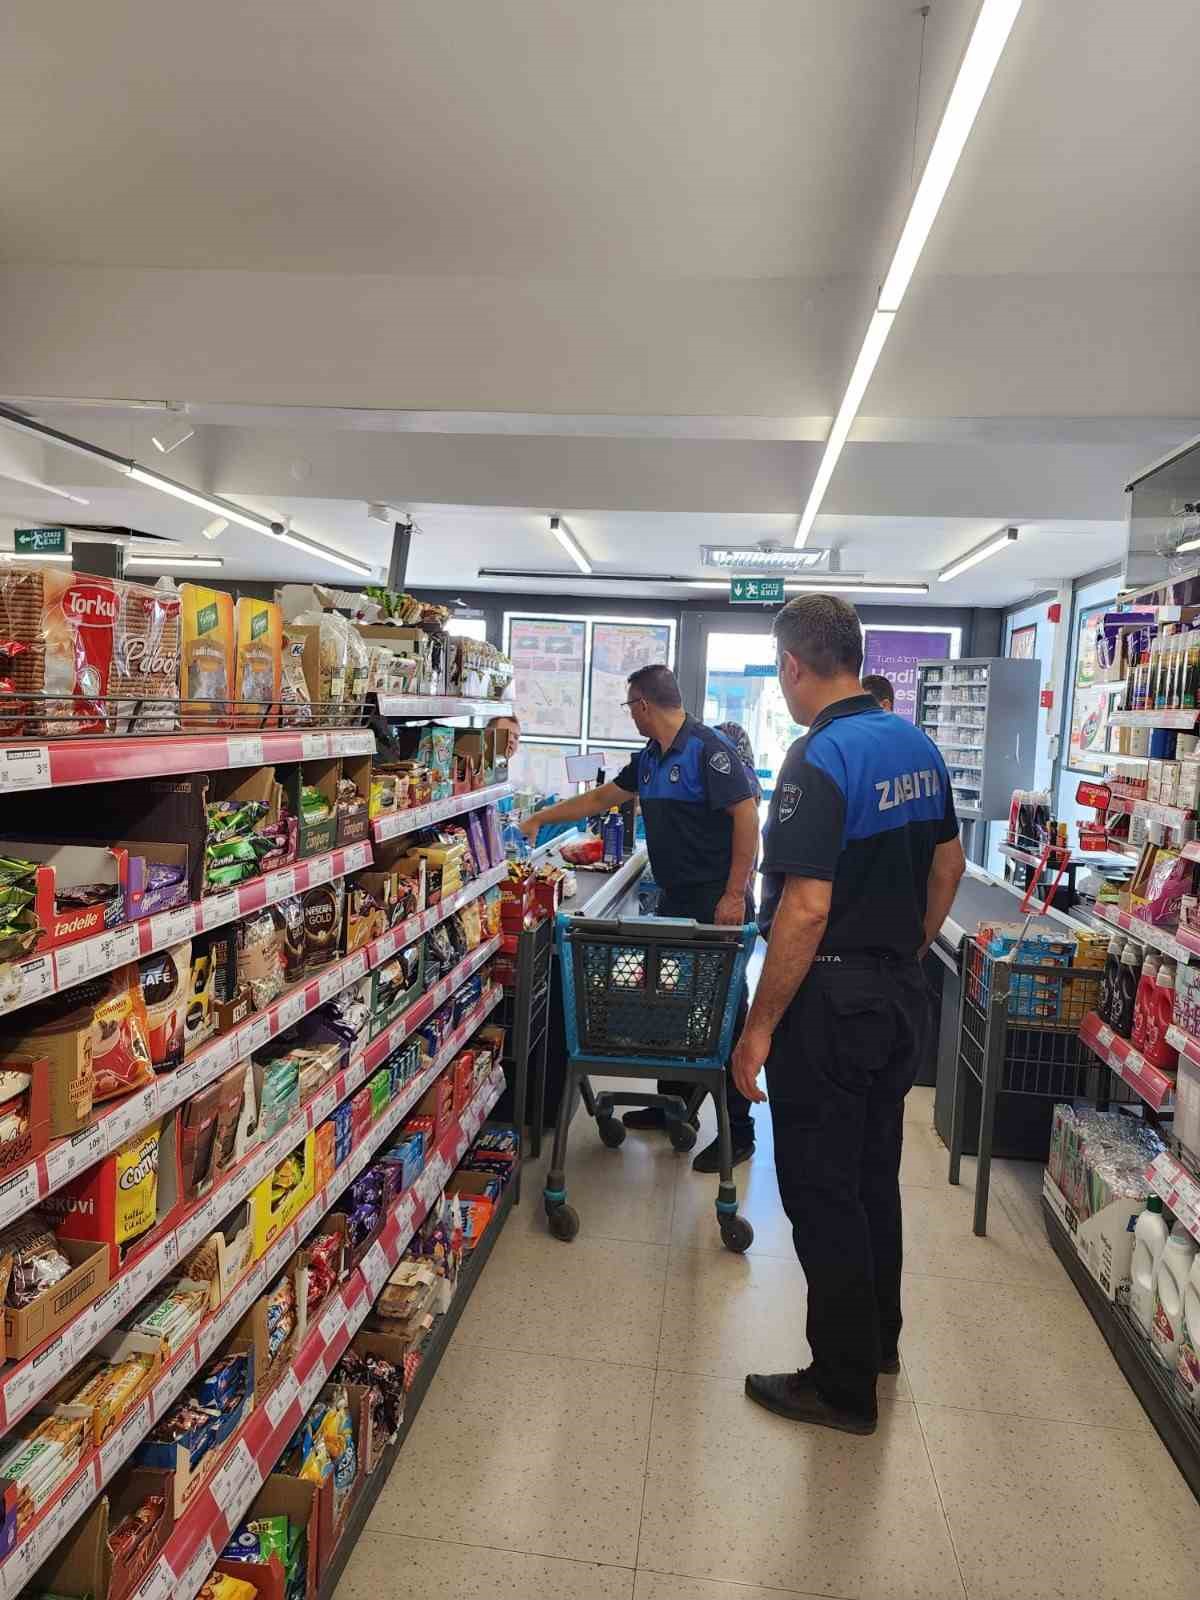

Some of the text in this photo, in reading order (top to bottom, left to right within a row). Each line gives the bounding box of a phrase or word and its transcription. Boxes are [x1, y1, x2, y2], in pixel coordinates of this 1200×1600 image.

[69, 592, 115, 616] Torku
[875, 769, 940, 812] ZABITA
[54, 912, 99, 937] tadelle
[309, 914, 333, 925] GOLD
